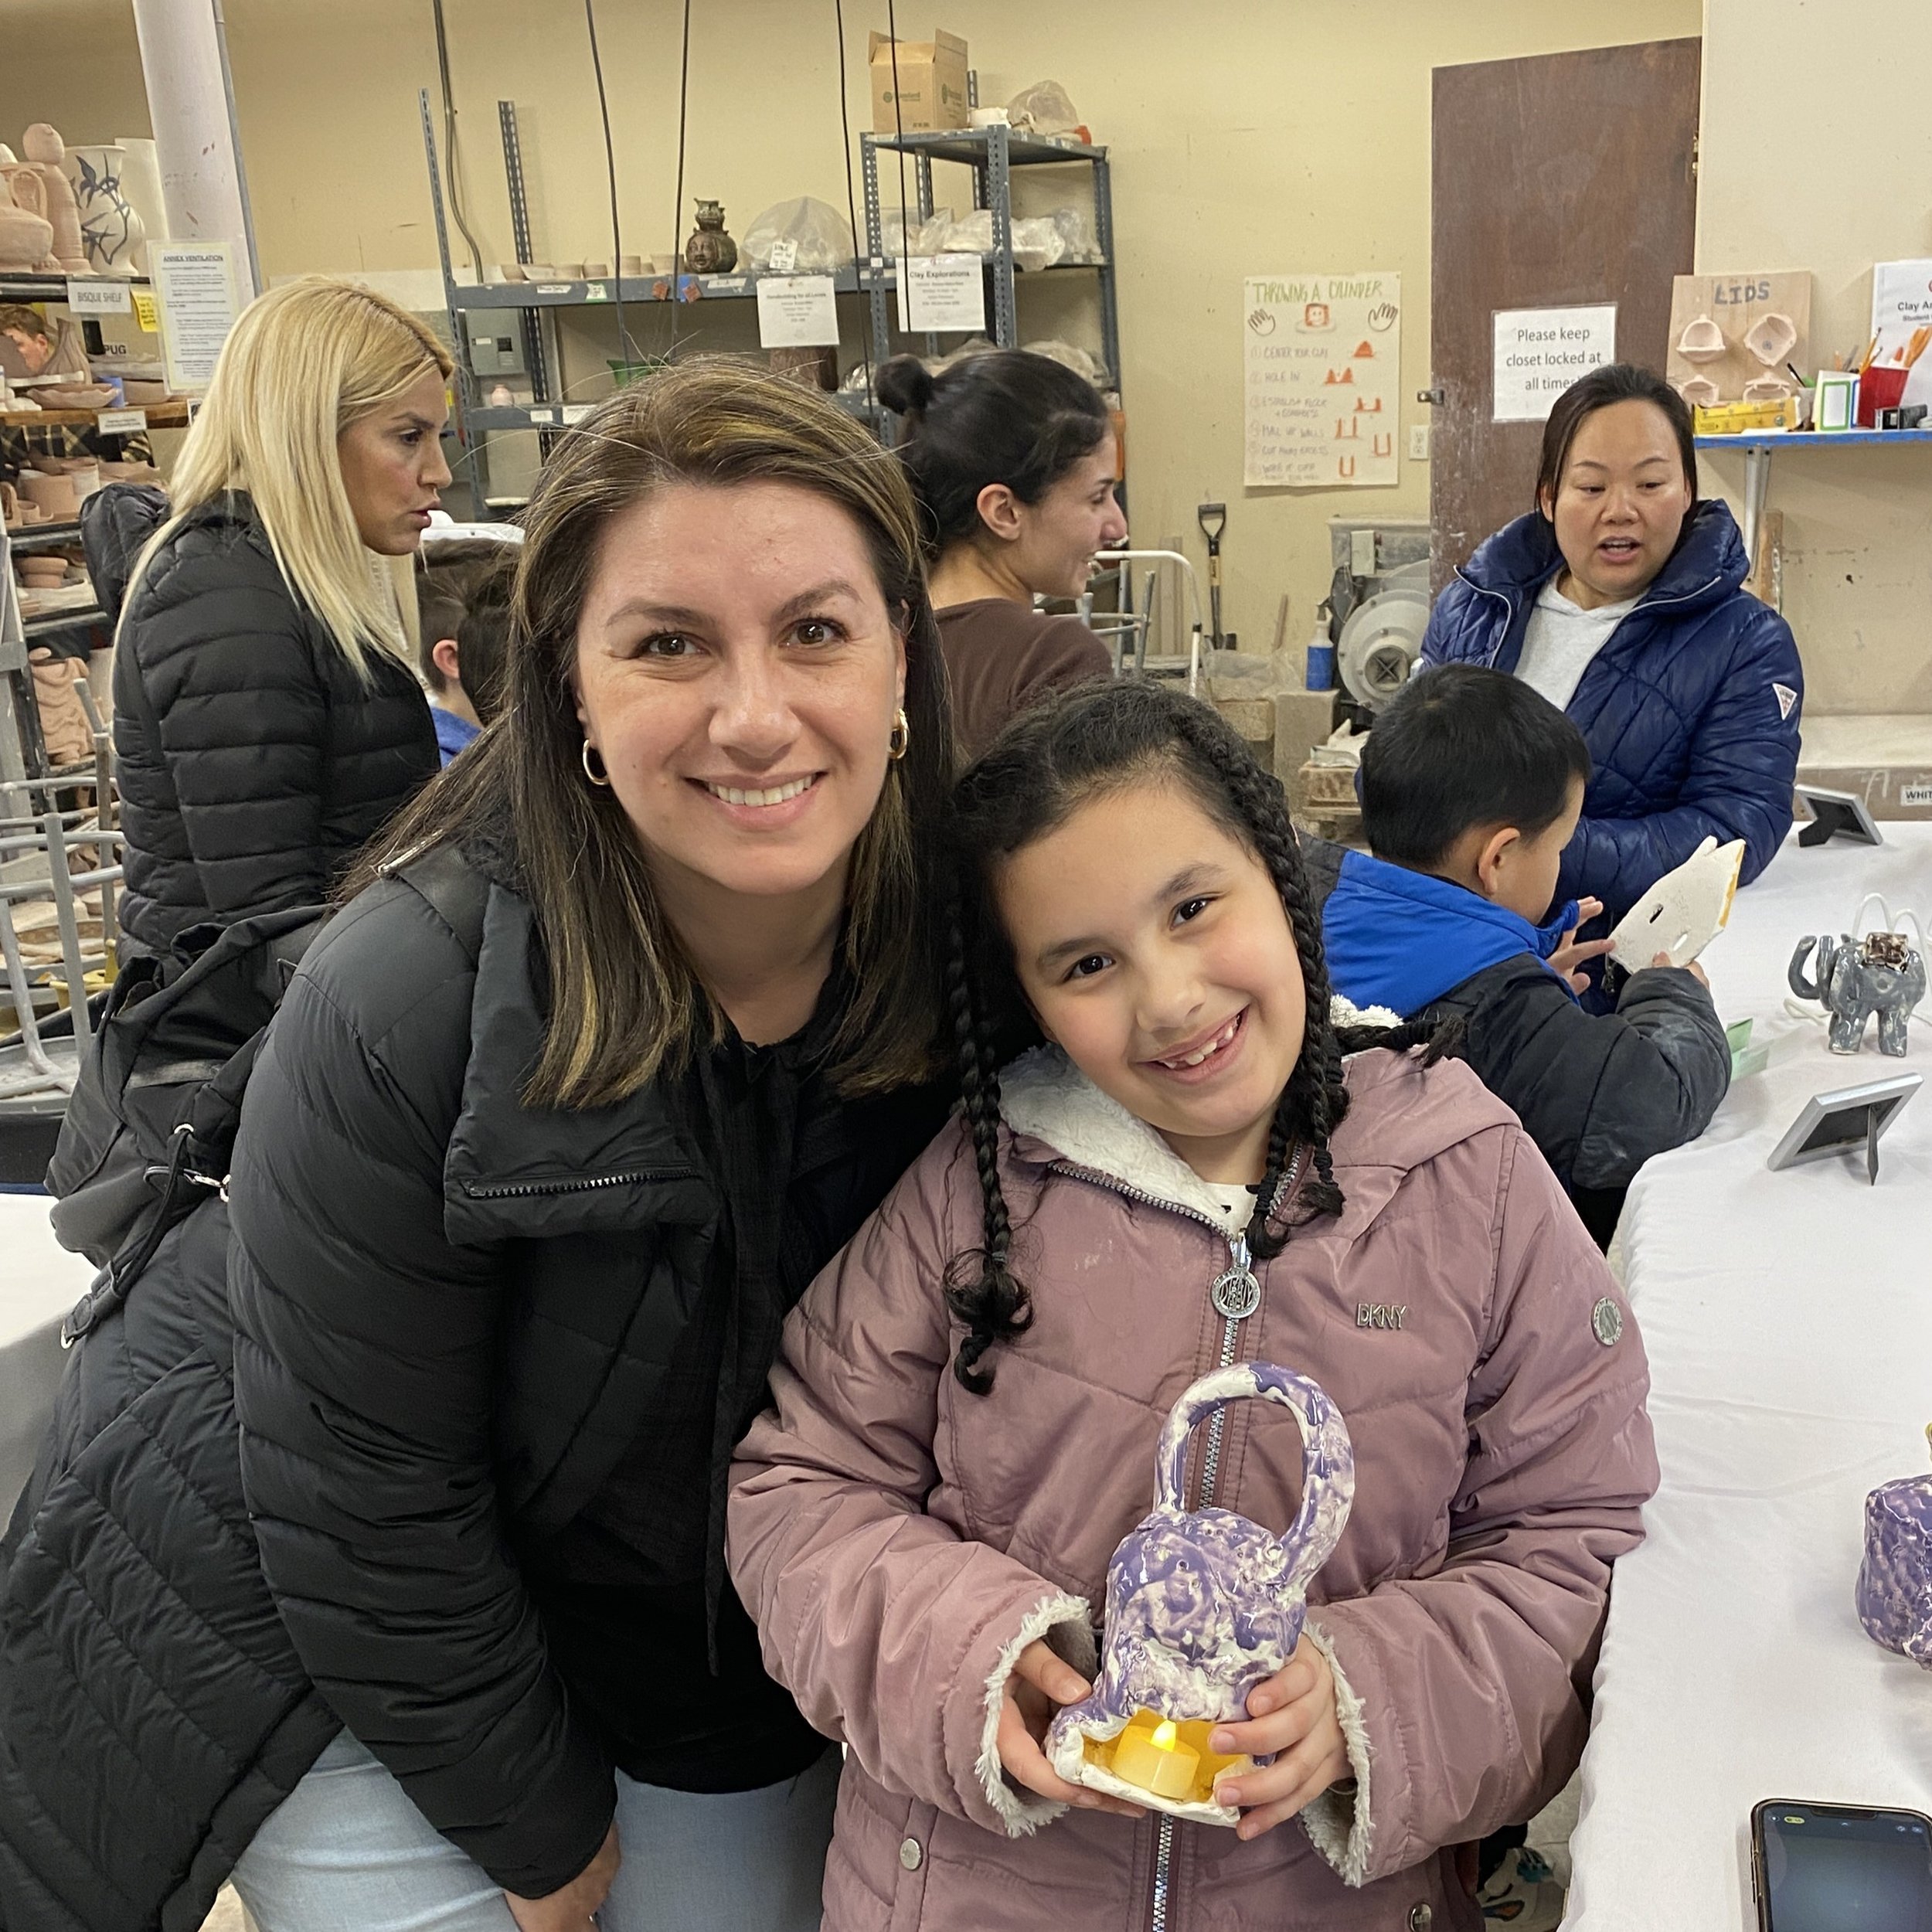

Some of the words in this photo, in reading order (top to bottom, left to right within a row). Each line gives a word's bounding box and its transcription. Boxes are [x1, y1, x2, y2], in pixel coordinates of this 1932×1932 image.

[926, 270, 971, 279] Explorations
[77, 292, 101, 303] BISQUE
[103, 292, 122, 303] SHELF
[1252, 282, 1308, 303] THROWING
[1311, 282, 1321, 301] A
[1328, 280, 1383, 300] CYLINDER
[1714, 281, 1771, 305] LIDS
[1897, 301, 1920, 312] Clay
[1517, 328, 1556, 342] Please
[1560, 327, 1590, 342] keep
[1506, 352, 1541, 367] closet
[1545, 351, 1585, 366] locked
[1589, 351, 1601, 364] at
[1264, 370, 1286, 383] HOLE
[1526, 376, 1539, 390] all
[1905, 790, 1932, 801] WHIT
[1356, 1302, 1407, 1330] DKNY
